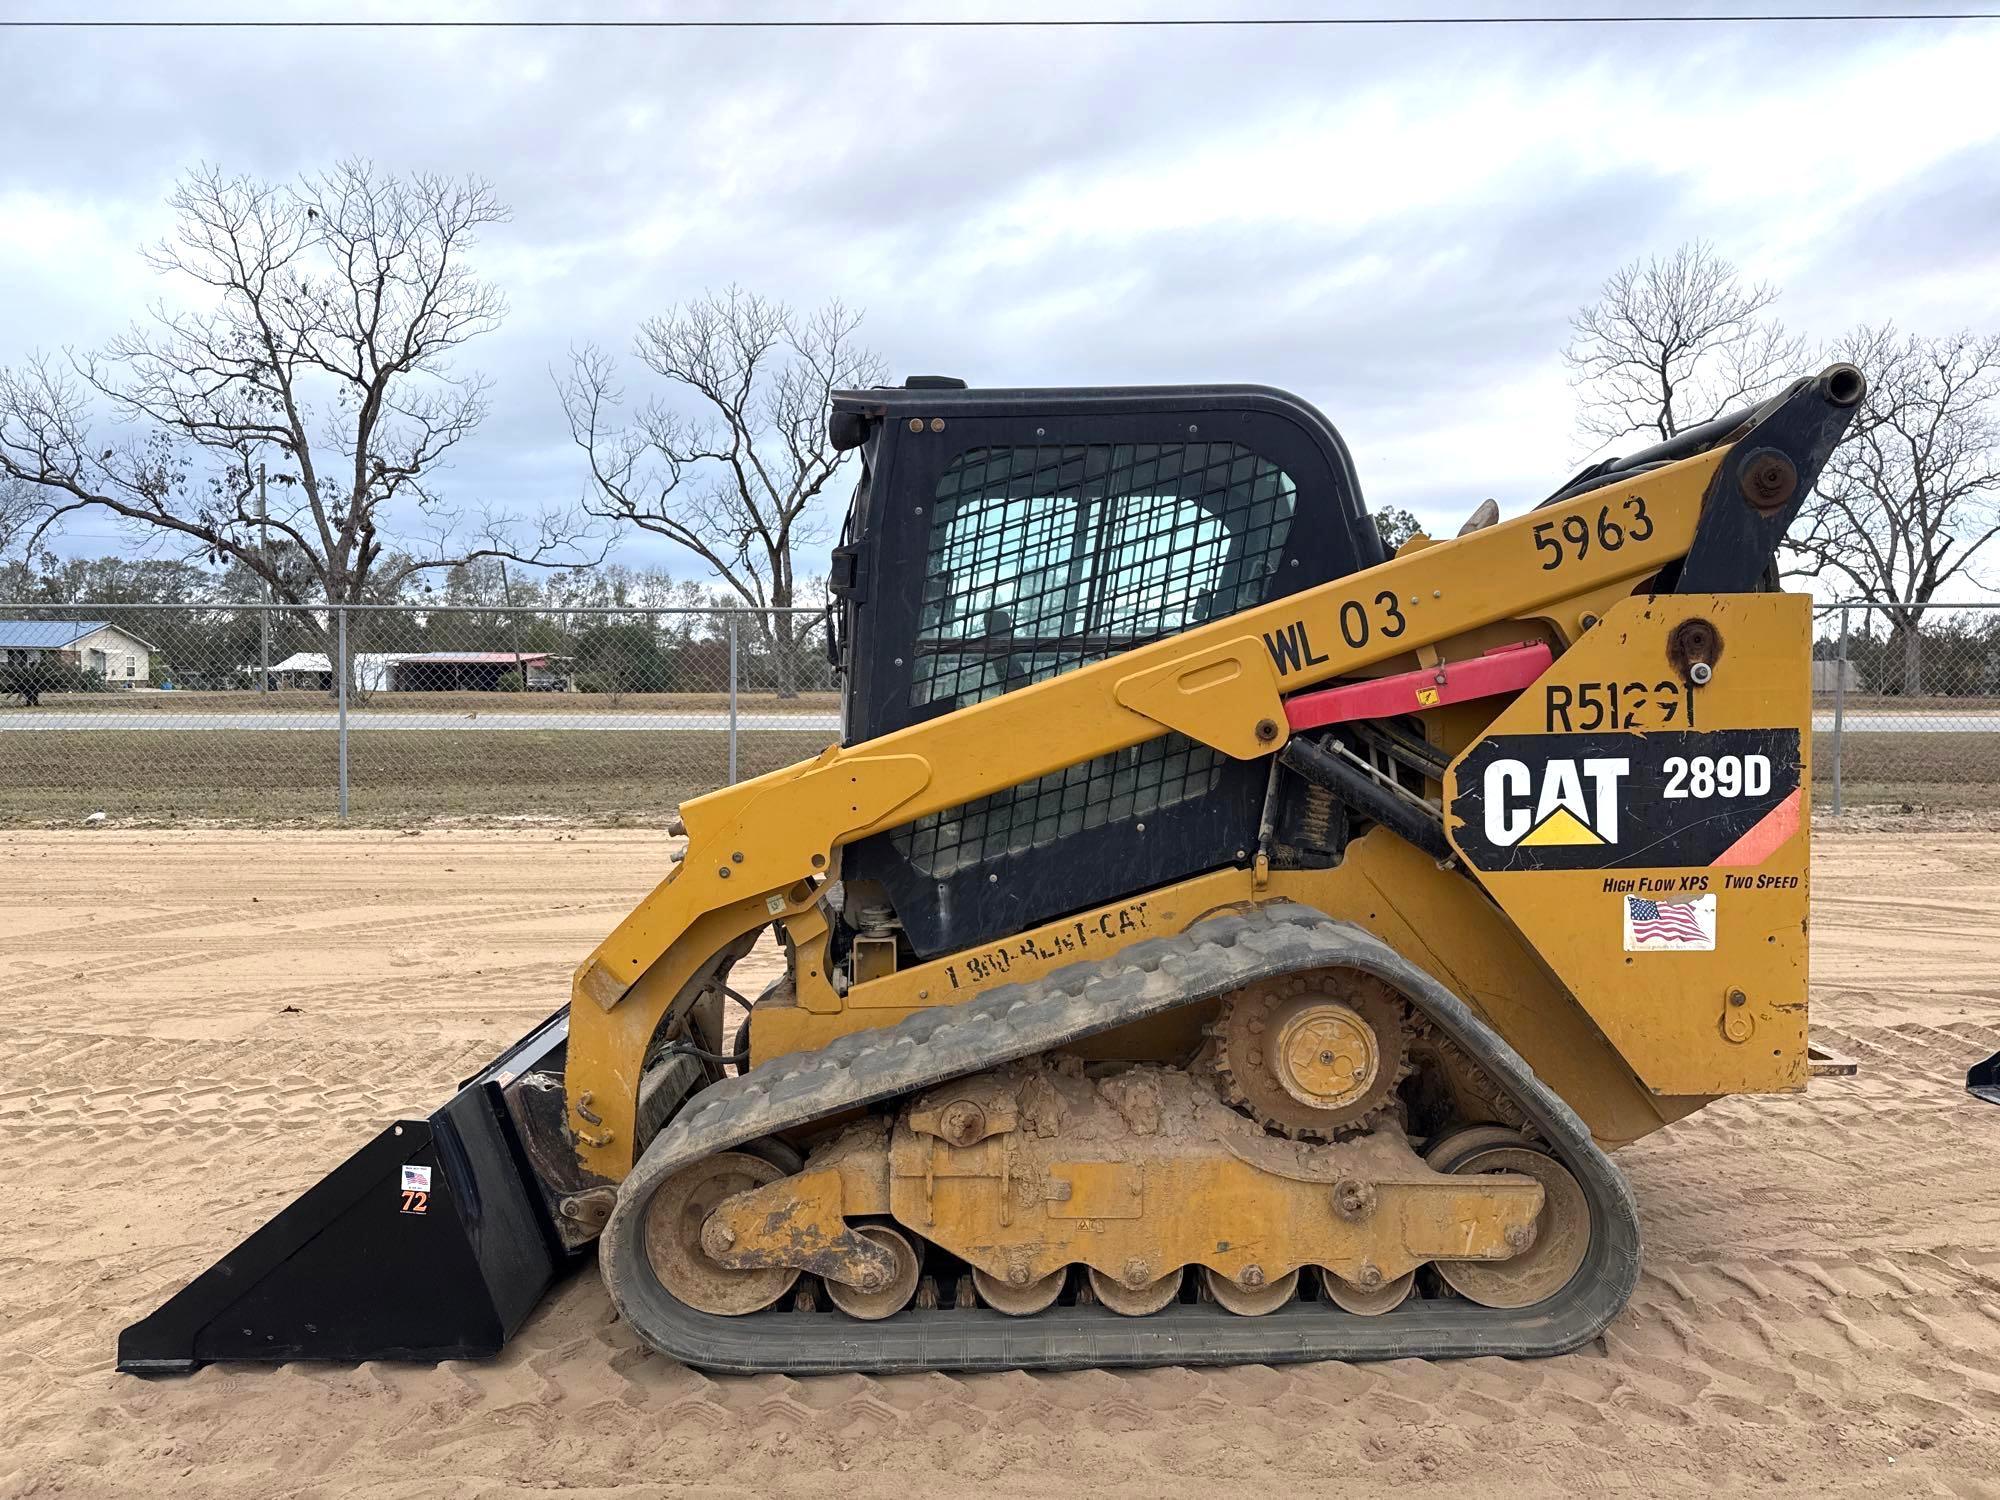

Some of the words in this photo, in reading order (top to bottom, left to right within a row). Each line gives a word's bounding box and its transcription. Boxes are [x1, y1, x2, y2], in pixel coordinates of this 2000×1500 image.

[1533, 495, 1654, 571] 5963
[1262, 620, 1330, 677] WL
[1339, 590, 1407, 649] 03
[1484, 757, 1630, 848] CAT
[1662, 754, 1771, 799] 289D
[1678, 875, 1709, 891] XPS
[401, 1190, 427, 1212] 72
